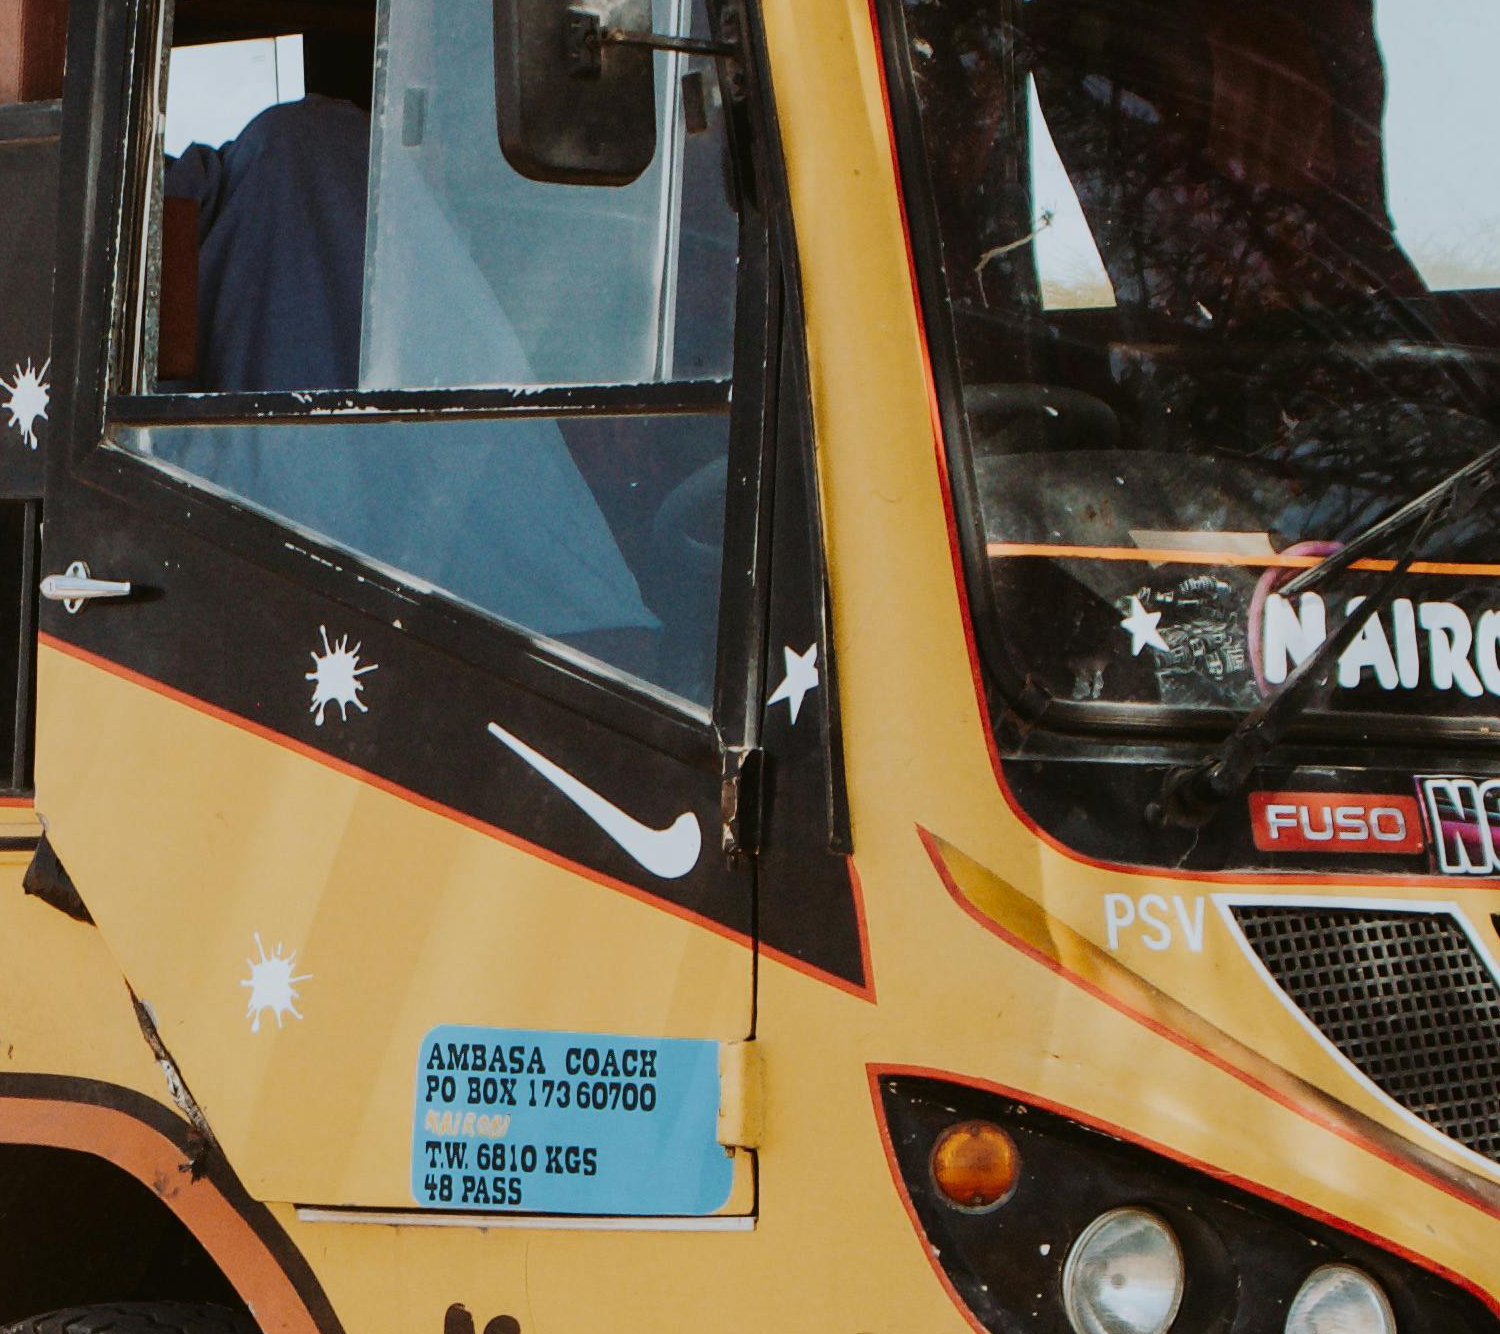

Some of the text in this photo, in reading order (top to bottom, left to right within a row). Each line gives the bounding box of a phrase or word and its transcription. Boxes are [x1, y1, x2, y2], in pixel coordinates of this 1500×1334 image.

[1265, 803, 1408, 843] FUSO
[1104, 892, 1206, 952] PSV
[426, 1042, 658, 1078] AMBASA COACH
[425, 1075, 657, 1111] PO BOX 173 60700
[425, 1140, 598, 1176] T.W. 6810 KGS
[424, 1174, 522, 1205] 48 PASS
